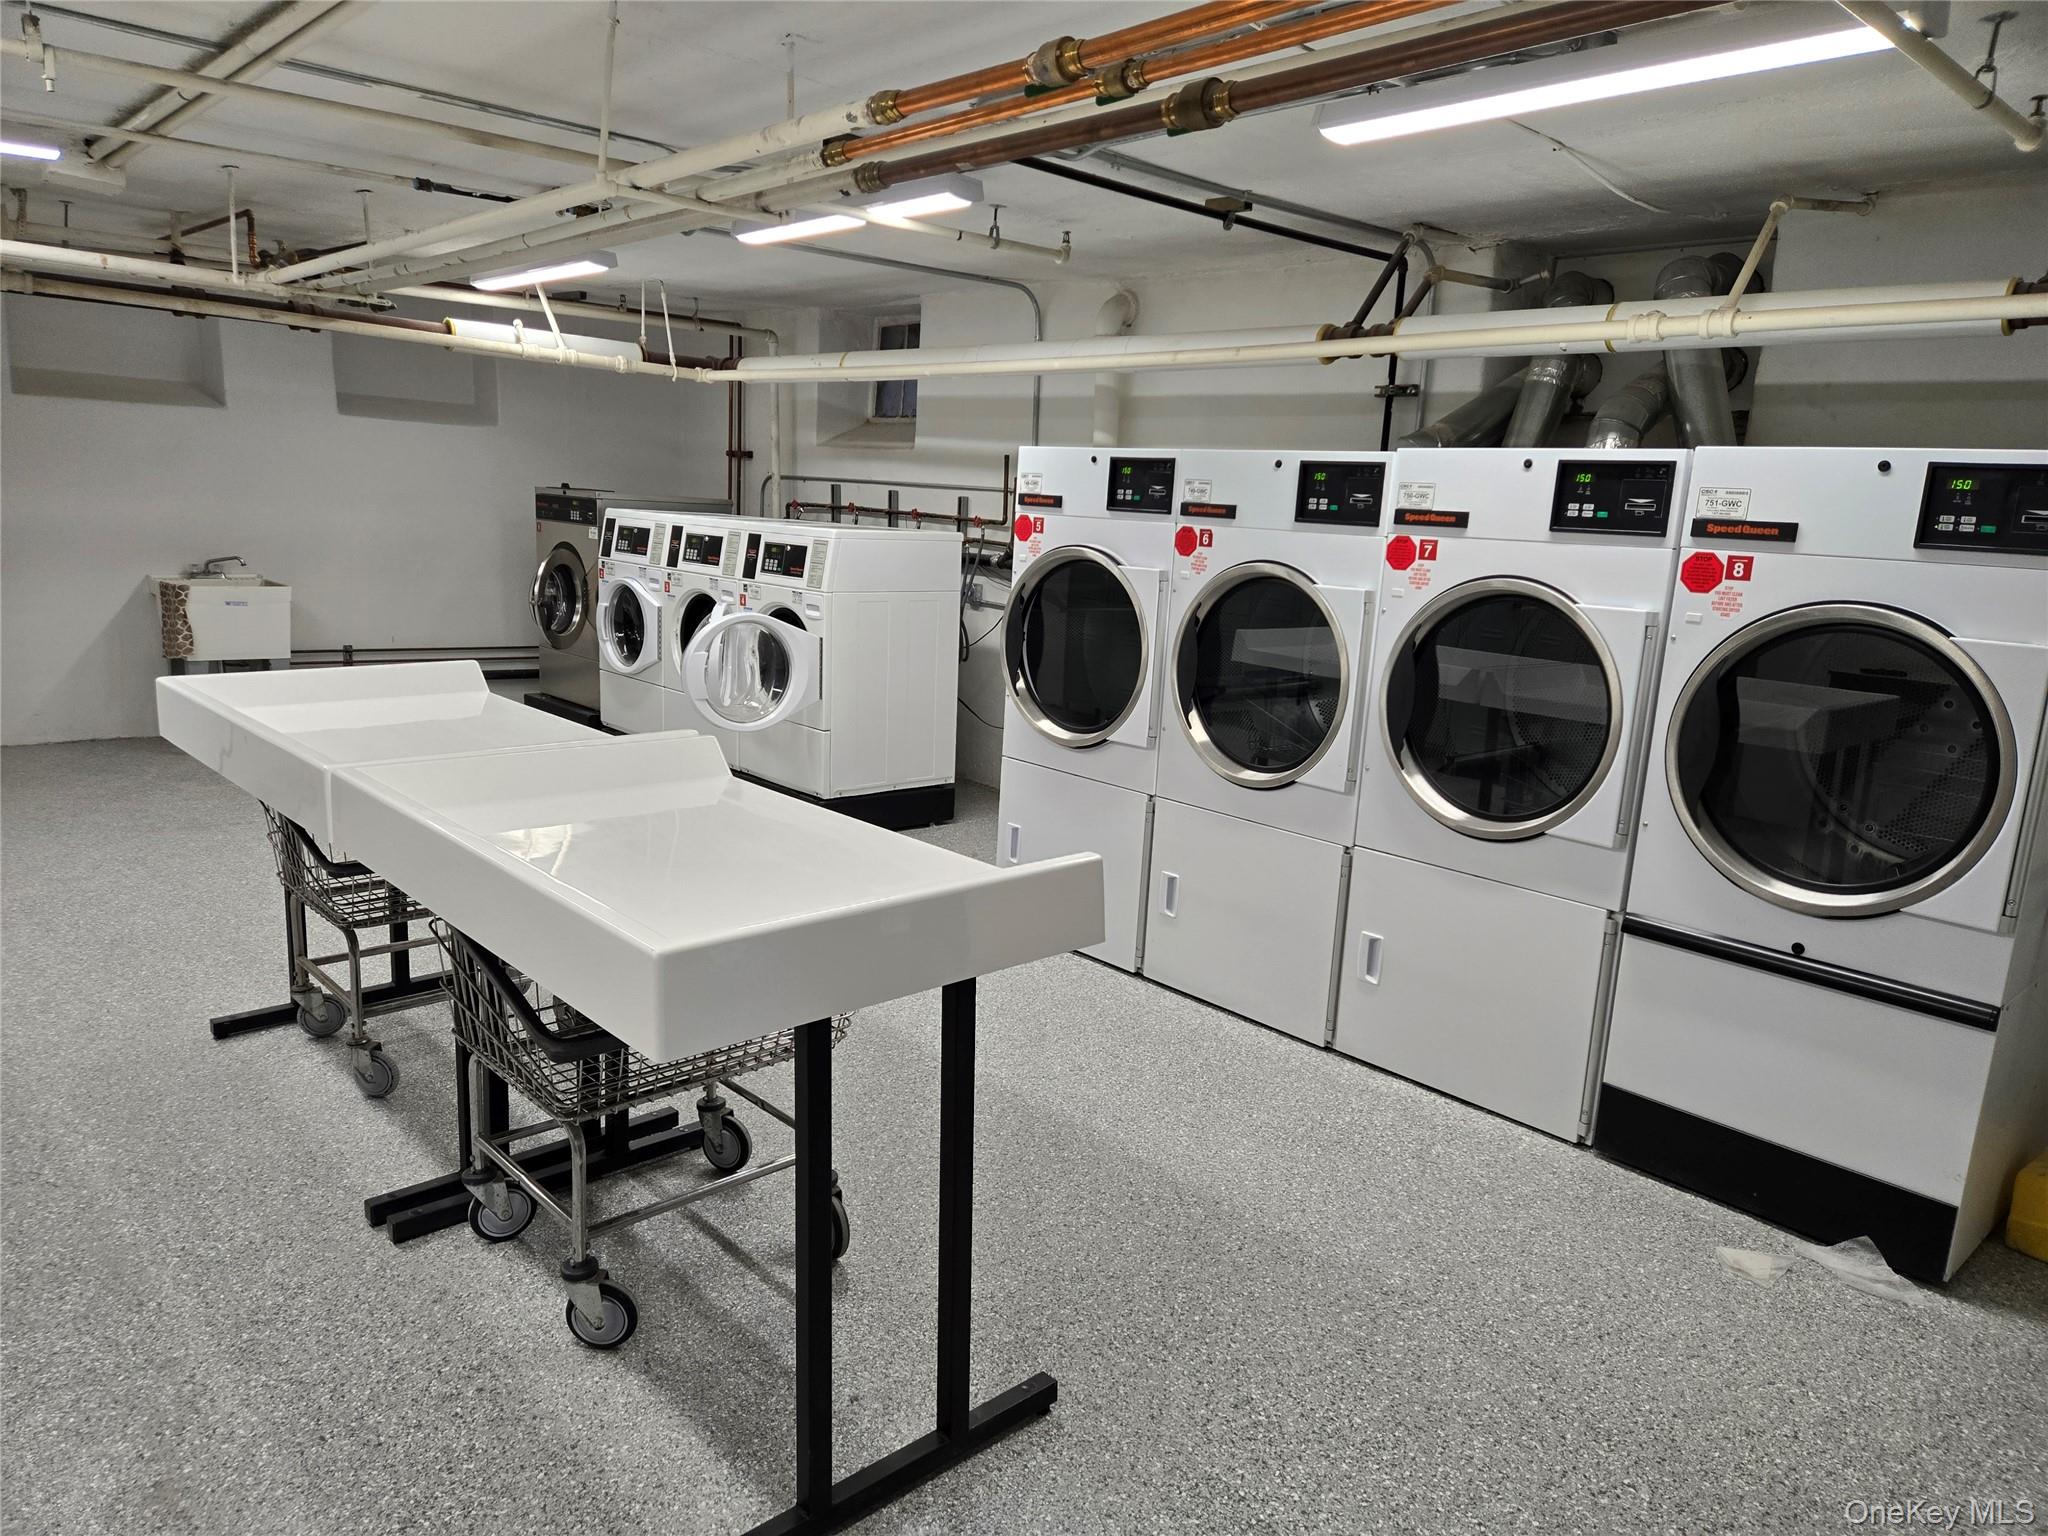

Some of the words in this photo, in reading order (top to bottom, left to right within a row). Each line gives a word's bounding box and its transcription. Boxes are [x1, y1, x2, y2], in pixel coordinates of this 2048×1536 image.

[1313, 472, 1326, 480] 150
[1575, 473, 1592, 482] 150
[1951, 479, 1973, 490] 150
[1704, 499, 1743, 508] 751-GWC
[1405, 512, 1430, 522] Speed
[1430, 513, 1457, 522] Queen
[1035, 521, 1041, 532] 5
[1706, 523, 1742, 534] Speed
[1742, 525, 1779, 535] Queen
[1202, 533, 1209, 545] 6
[1423, 544, 1433, 558] 7
[1732, 562, 1745, 577] 8
